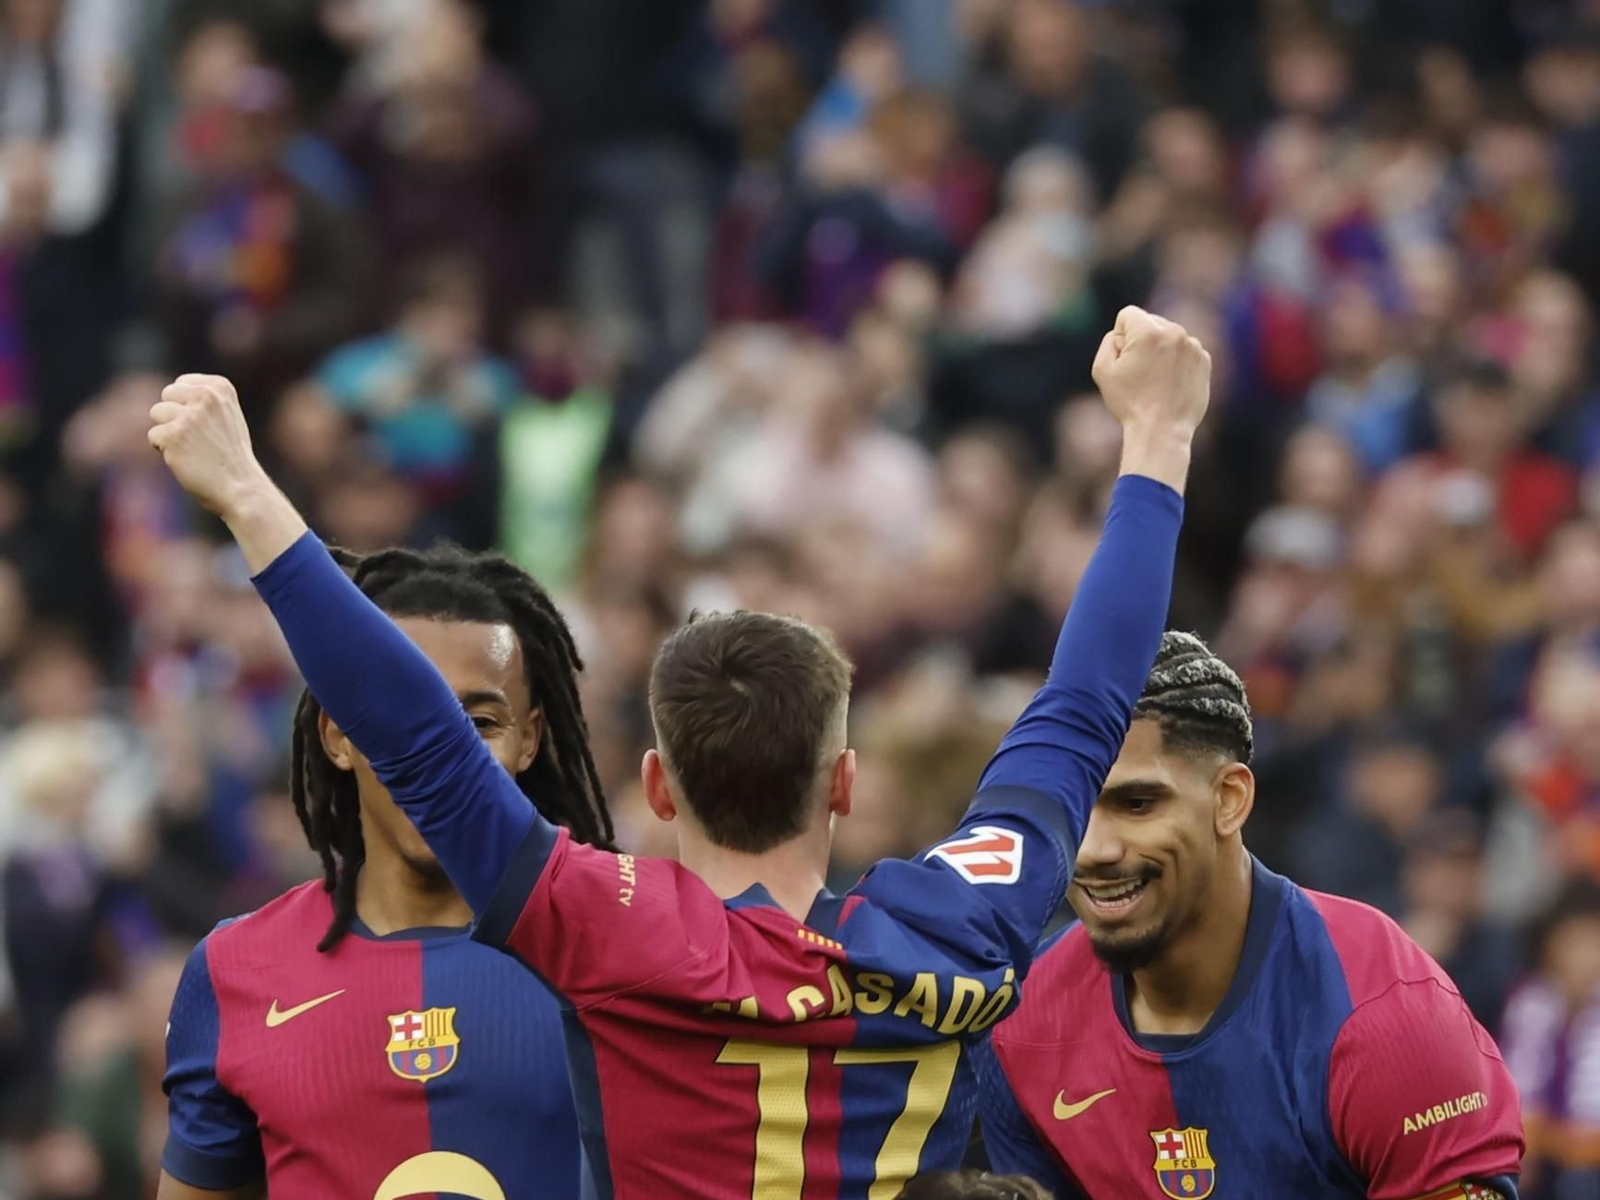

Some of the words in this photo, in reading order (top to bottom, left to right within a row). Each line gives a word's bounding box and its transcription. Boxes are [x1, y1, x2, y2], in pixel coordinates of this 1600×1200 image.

[619, 888, 634, 907] tv
[408, 1037, 436, 1049] FCB
[1403, 1091, 1481, 1135] AMBILIGHT
[1173, 1159, 1197, 1169] FCB
